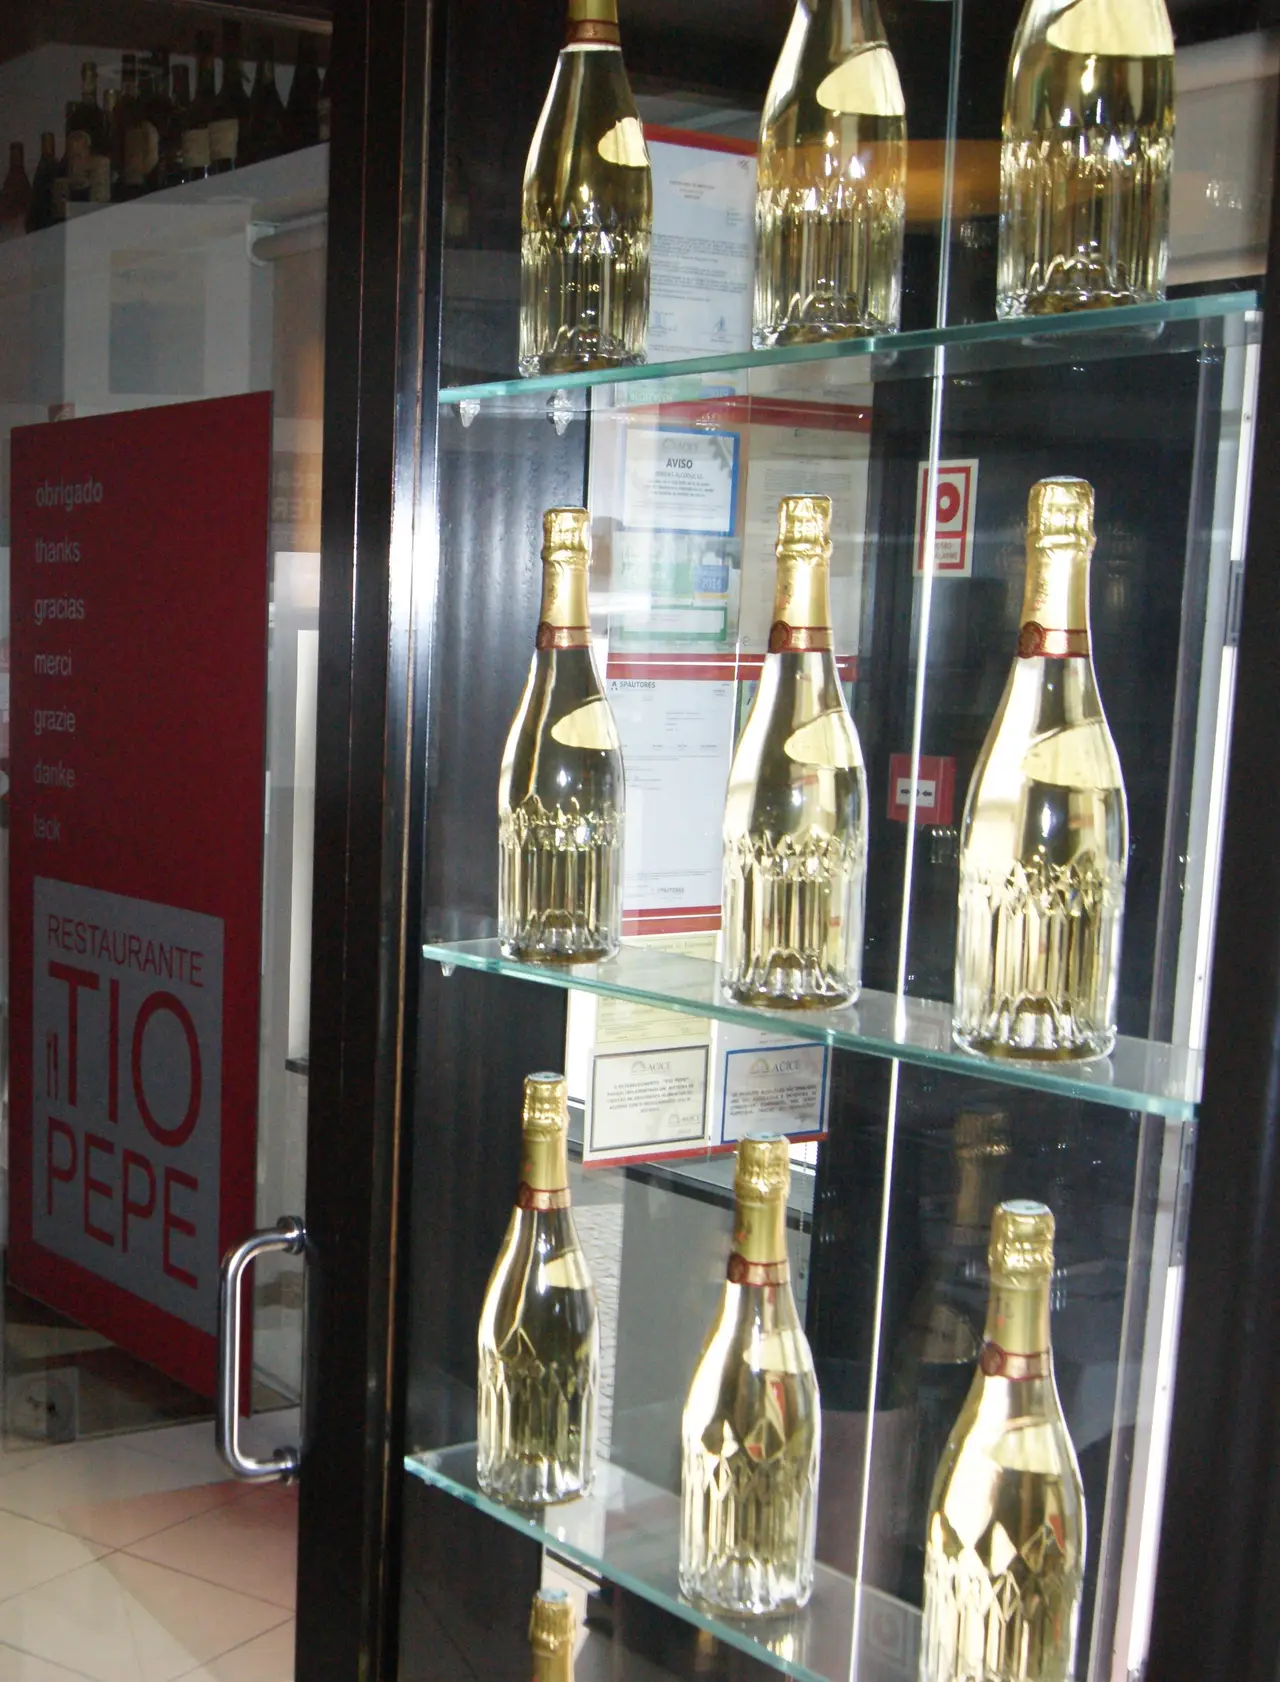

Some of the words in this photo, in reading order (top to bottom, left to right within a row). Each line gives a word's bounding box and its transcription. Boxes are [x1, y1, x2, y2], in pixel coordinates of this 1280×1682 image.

[665, 458, 693, 469] AVISO
[35, 477, 104, 511] obrigado
[35, 538, 81, 563] thanks
[34, 593, 85, 625] gracias
[34, 650, 72, 676] merci
[619, 681, 656, 689] SPAUTORES
[34, 706, 76, 735] grazie
[33, 760, 76, 788] danke
[33, 815, 61, 841] tack
[47, 914, 205, 988] RESTAURANTE
[47, 960, 202, 1148] TIO
[47, 1115, 199, 1290] PEPE
